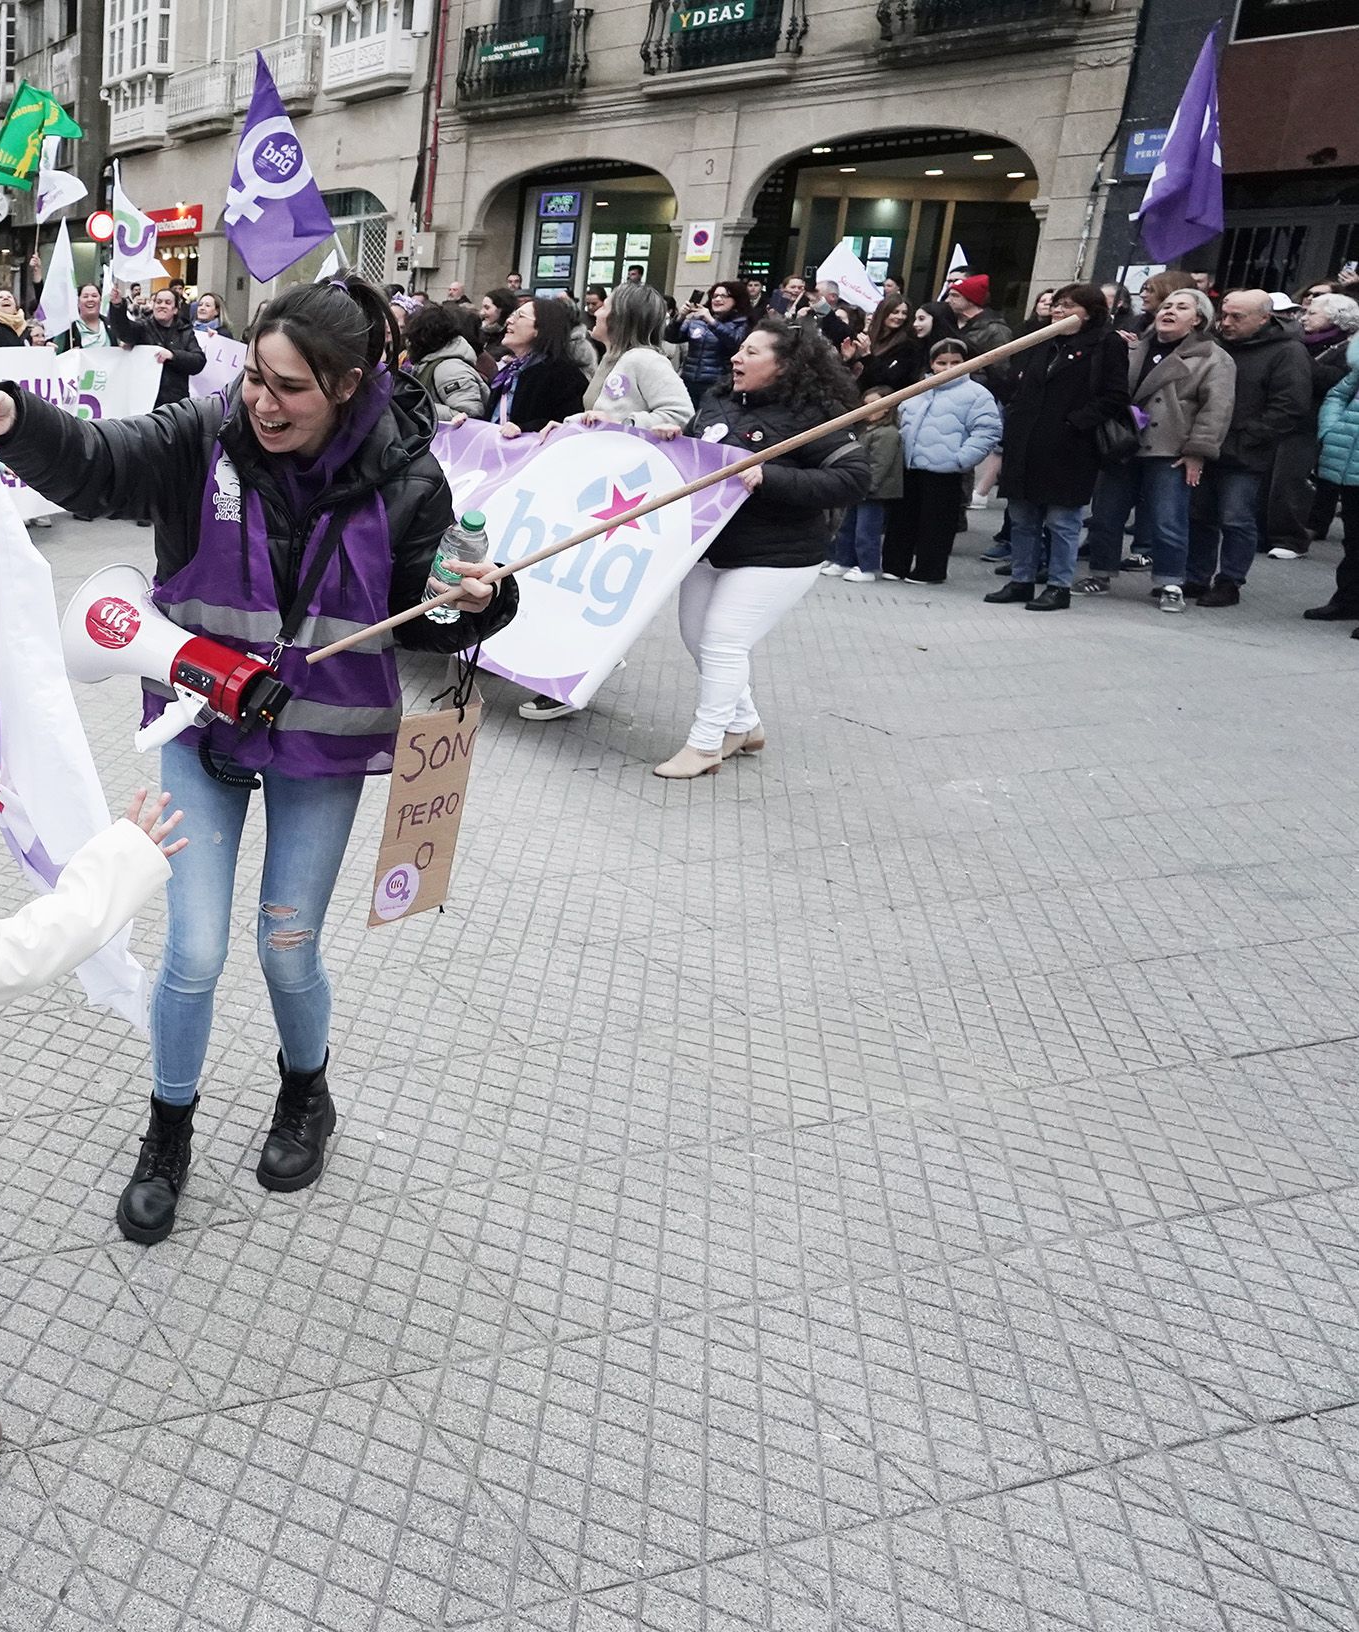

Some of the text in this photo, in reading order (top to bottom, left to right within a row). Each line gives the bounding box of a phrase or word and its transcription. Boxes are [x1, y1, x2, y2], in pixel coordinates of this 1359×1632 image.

[680, 2, 745, 28] YDEAS
[262, 141, 294, 176] bng
[705, 158, 715, 176] 3
[493, 488, 653, 627] bng
[400, 725, 478, 783] SON
[396, 792, 460, 840] PERO
